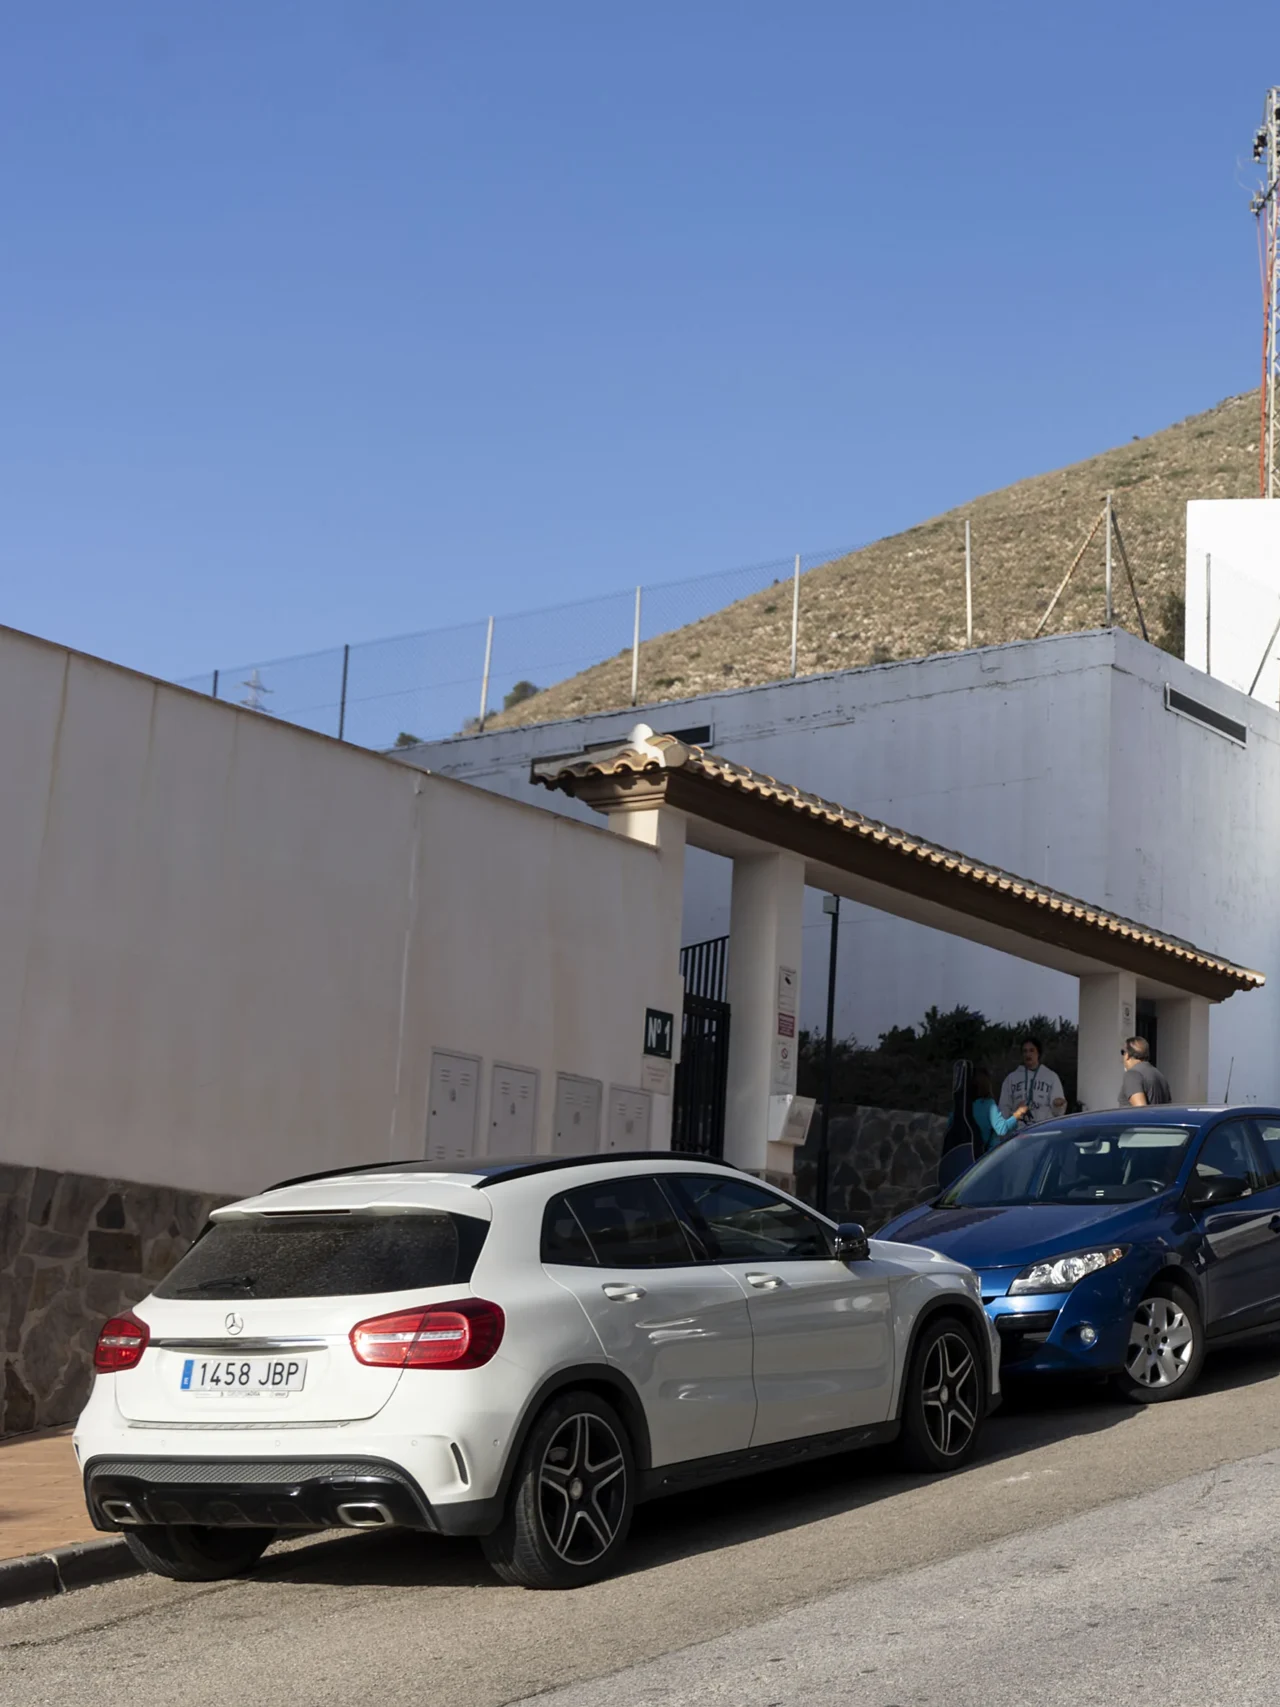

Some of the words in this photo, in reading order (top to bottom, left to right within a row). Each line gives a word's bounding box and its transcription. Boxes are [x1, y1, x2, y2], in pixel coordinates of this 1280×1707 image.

[664, 1020, 672, 1052] 1
[200, 1362, 252, 1386] 1458
[257, 1362, 300, 1386] JBP
